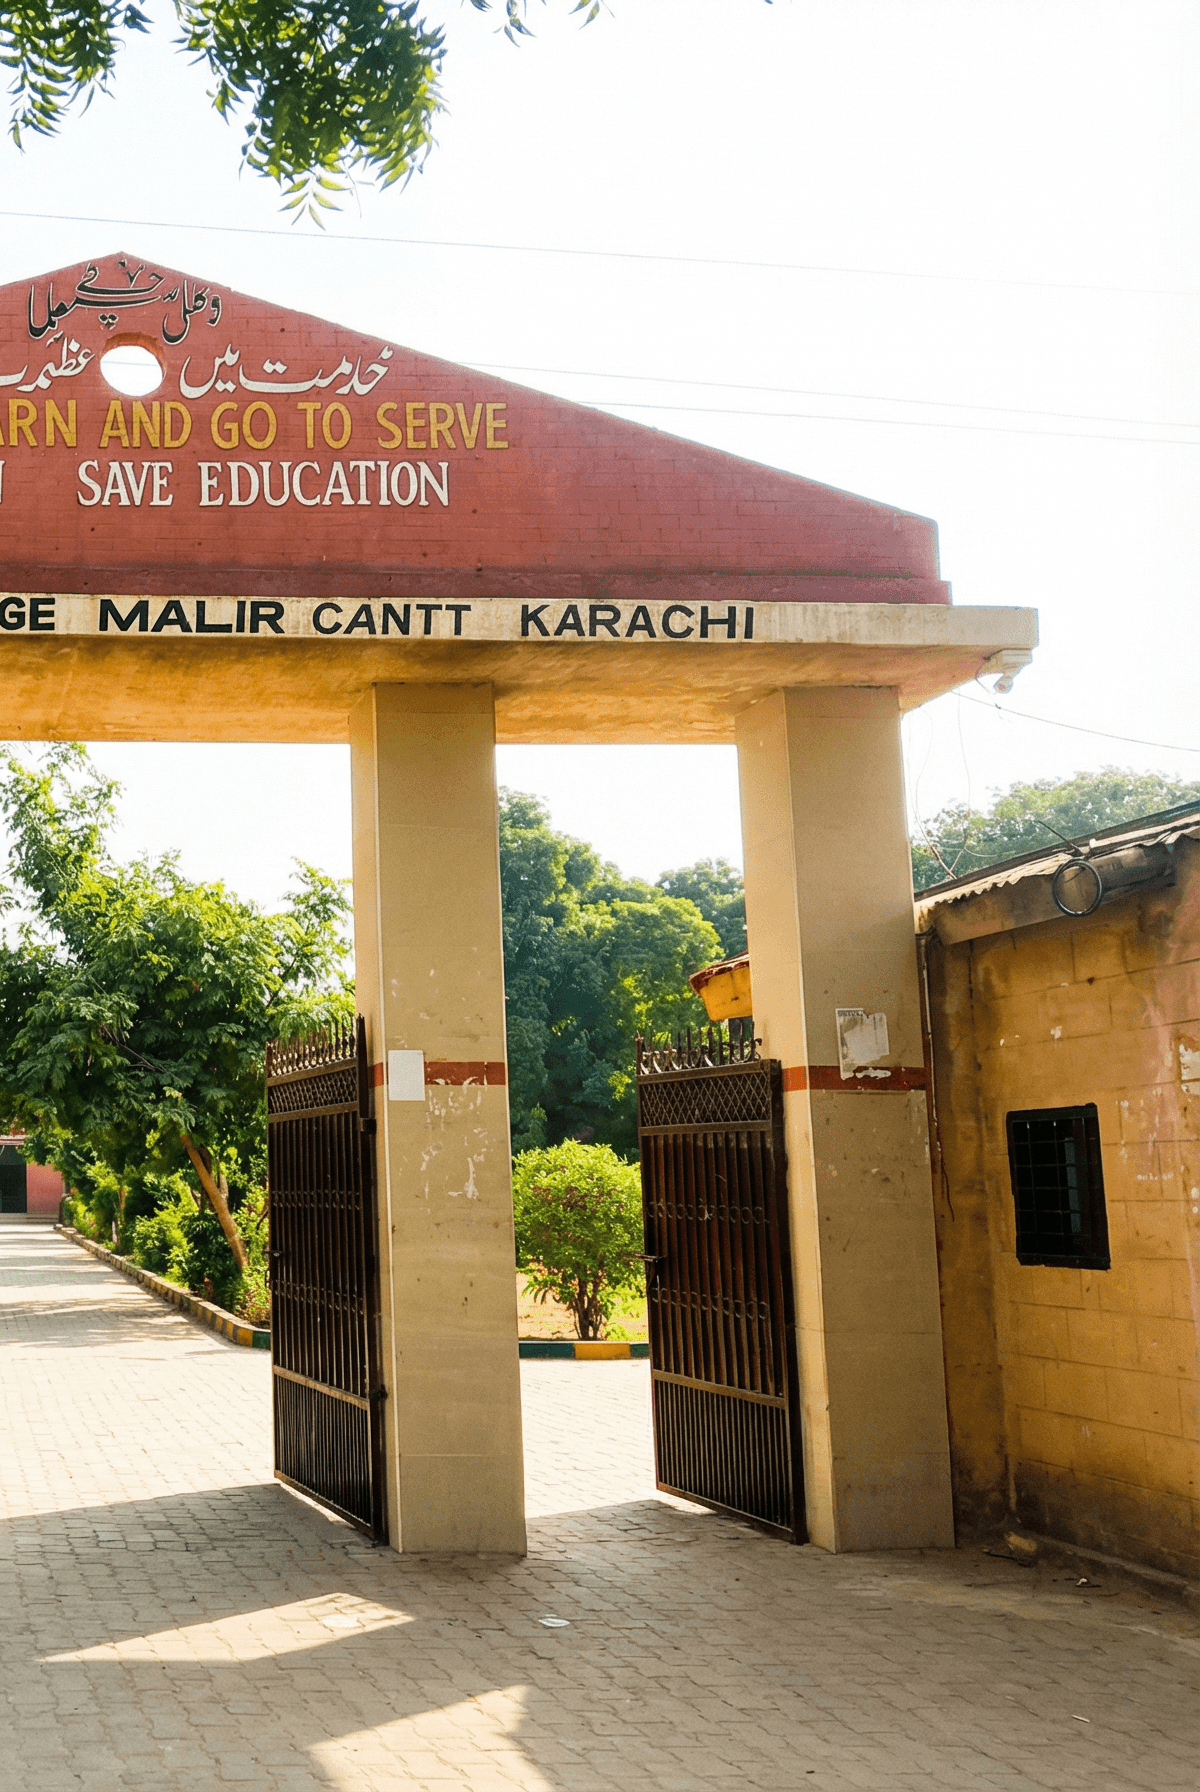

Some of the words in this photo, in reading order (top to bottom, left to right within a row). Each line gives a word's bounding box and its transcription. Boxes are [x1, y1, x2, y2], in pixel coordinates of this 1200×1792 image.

[99, 399, 193, 449] AND
[211, 400, 278, 450] GO
[297, 401, 353, 450] TO
[375, 401, 510, 450] SERVE
[77, 459, 174, 507] SAVE
[198, 460, 450, 507] EDUCATION
[99, 599, 285, 634] MALIR
[311, 602, 472, 636] CANTT
[520, 604, 754, 640] KARACHI
